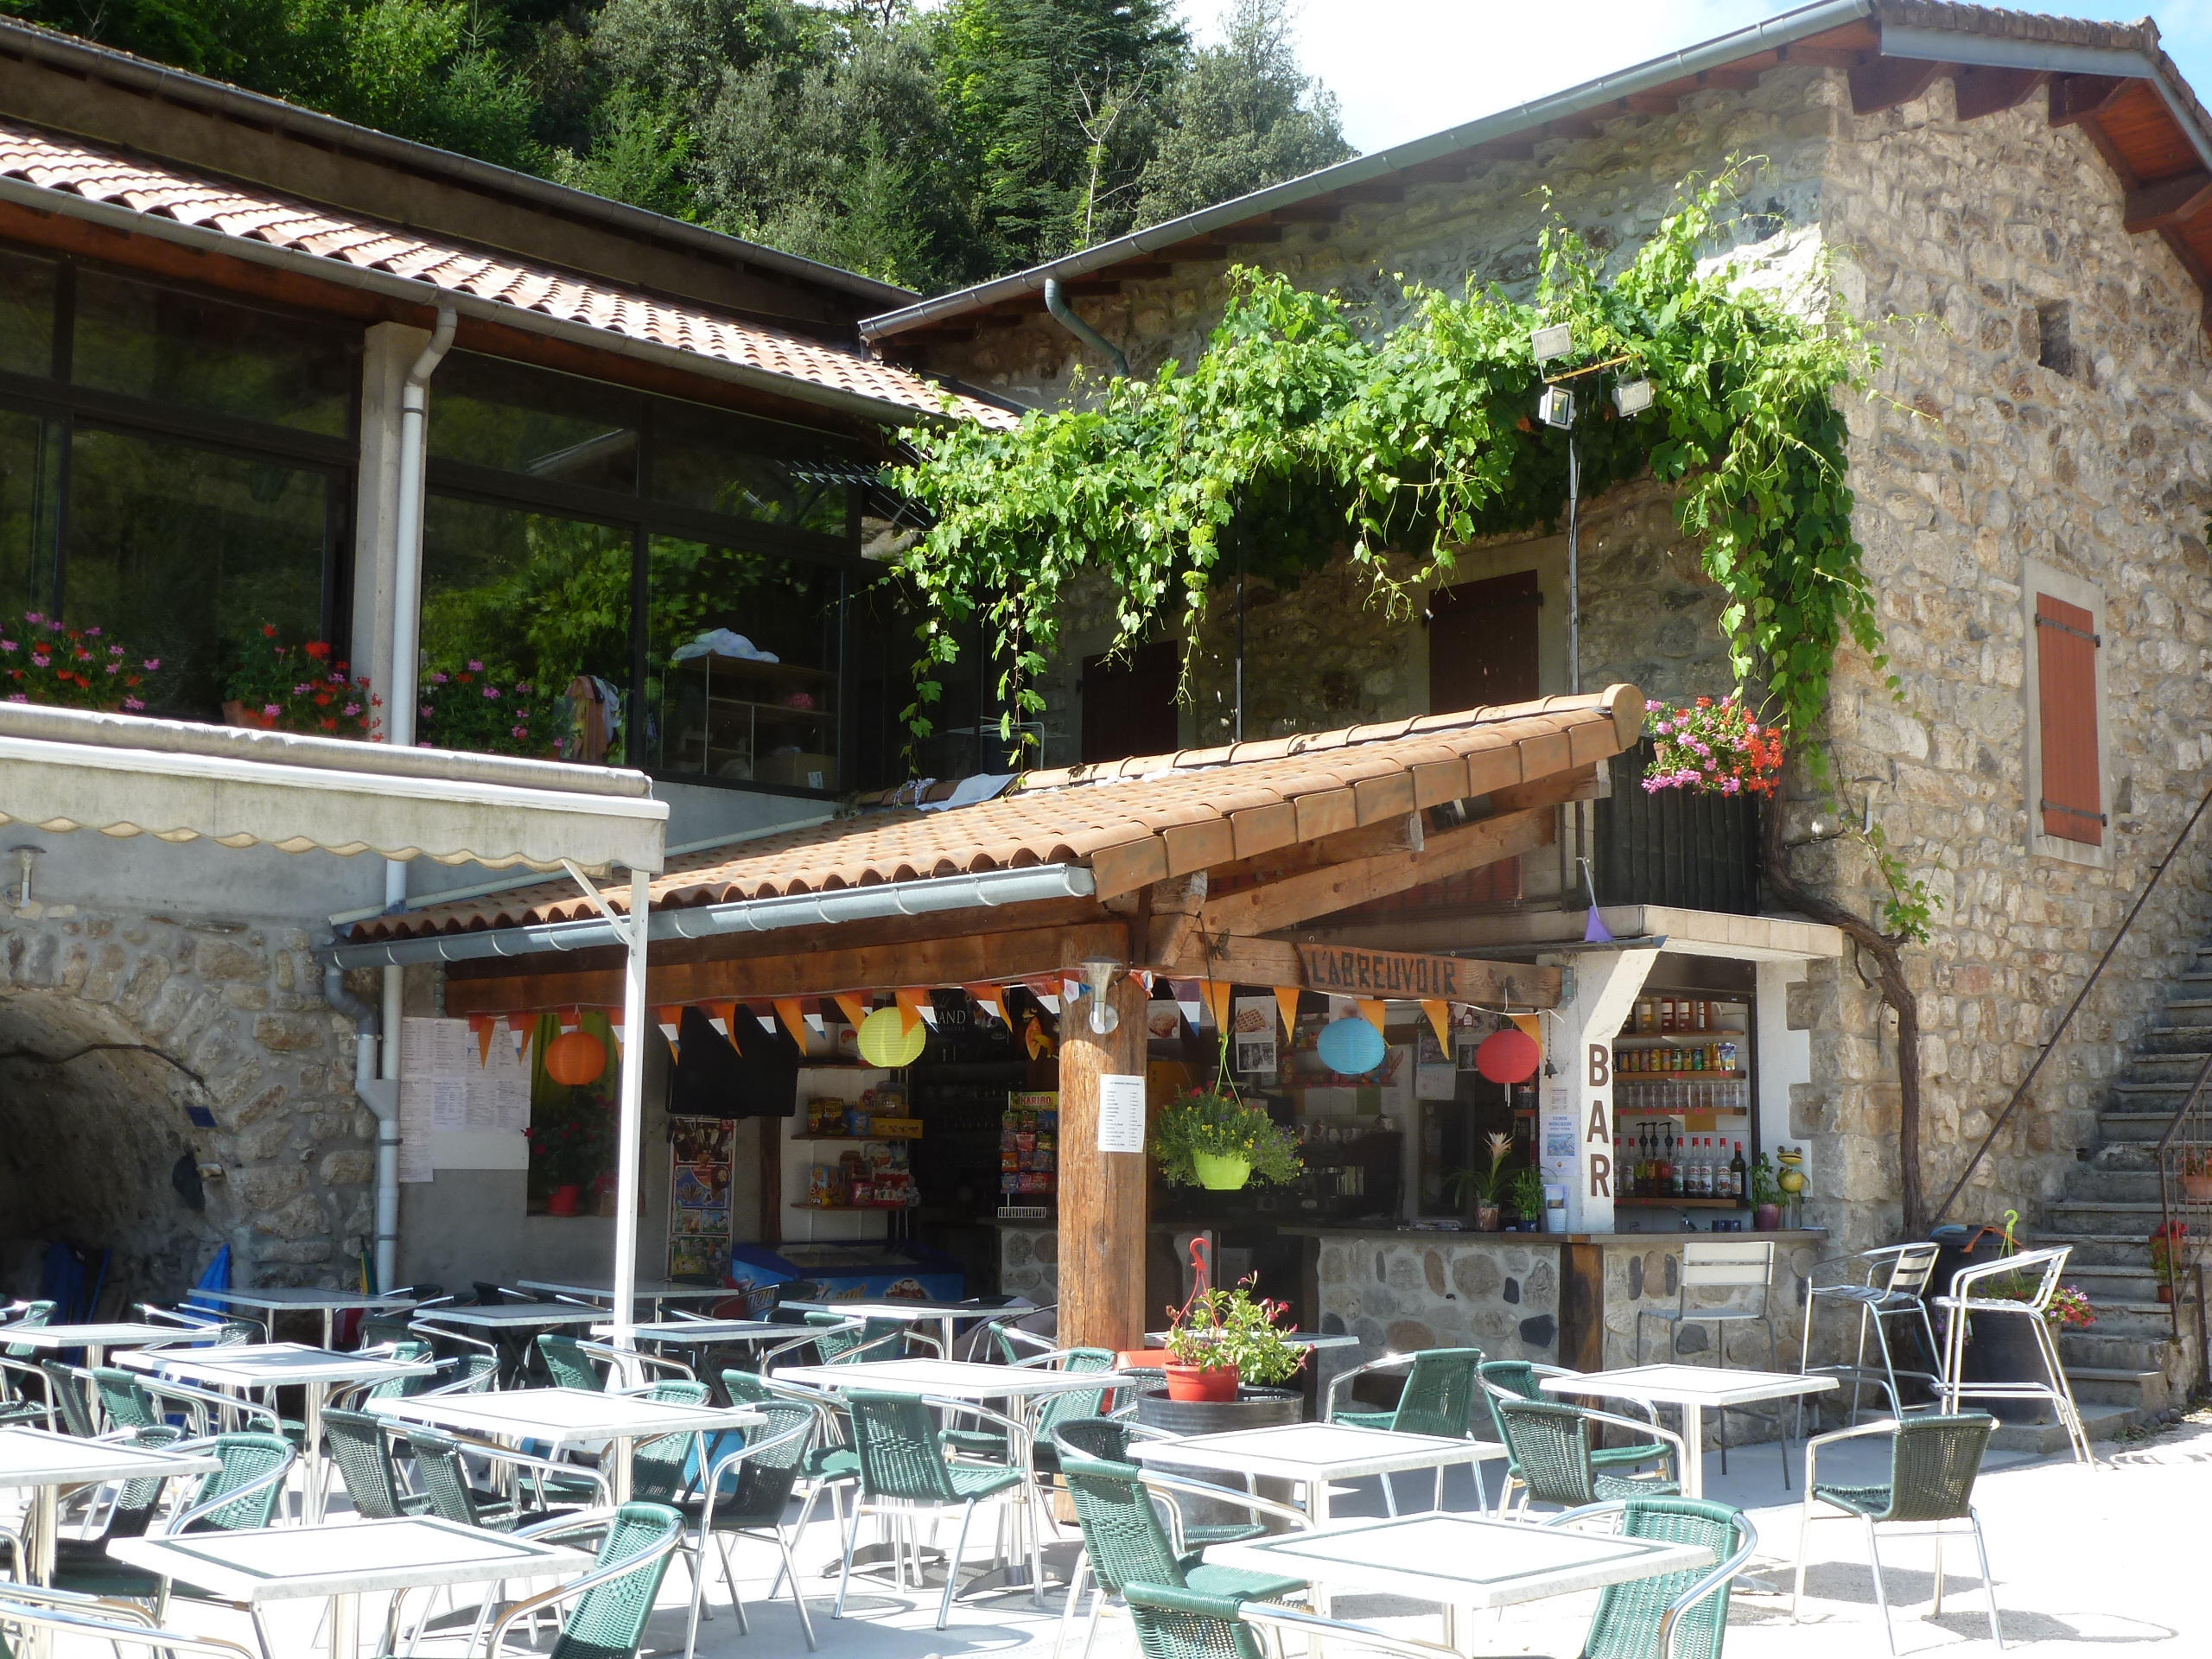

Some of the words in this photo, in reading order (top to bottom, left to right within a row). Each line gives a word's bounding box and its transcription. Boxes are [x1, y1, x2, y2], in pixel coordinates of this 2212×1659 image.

[1312, 950, 1458, 995] L'ABREUVOIR
[1020, 1096, 1052, 1105] HARIBO
[1586, 1043, 1611, 1198] BAR
